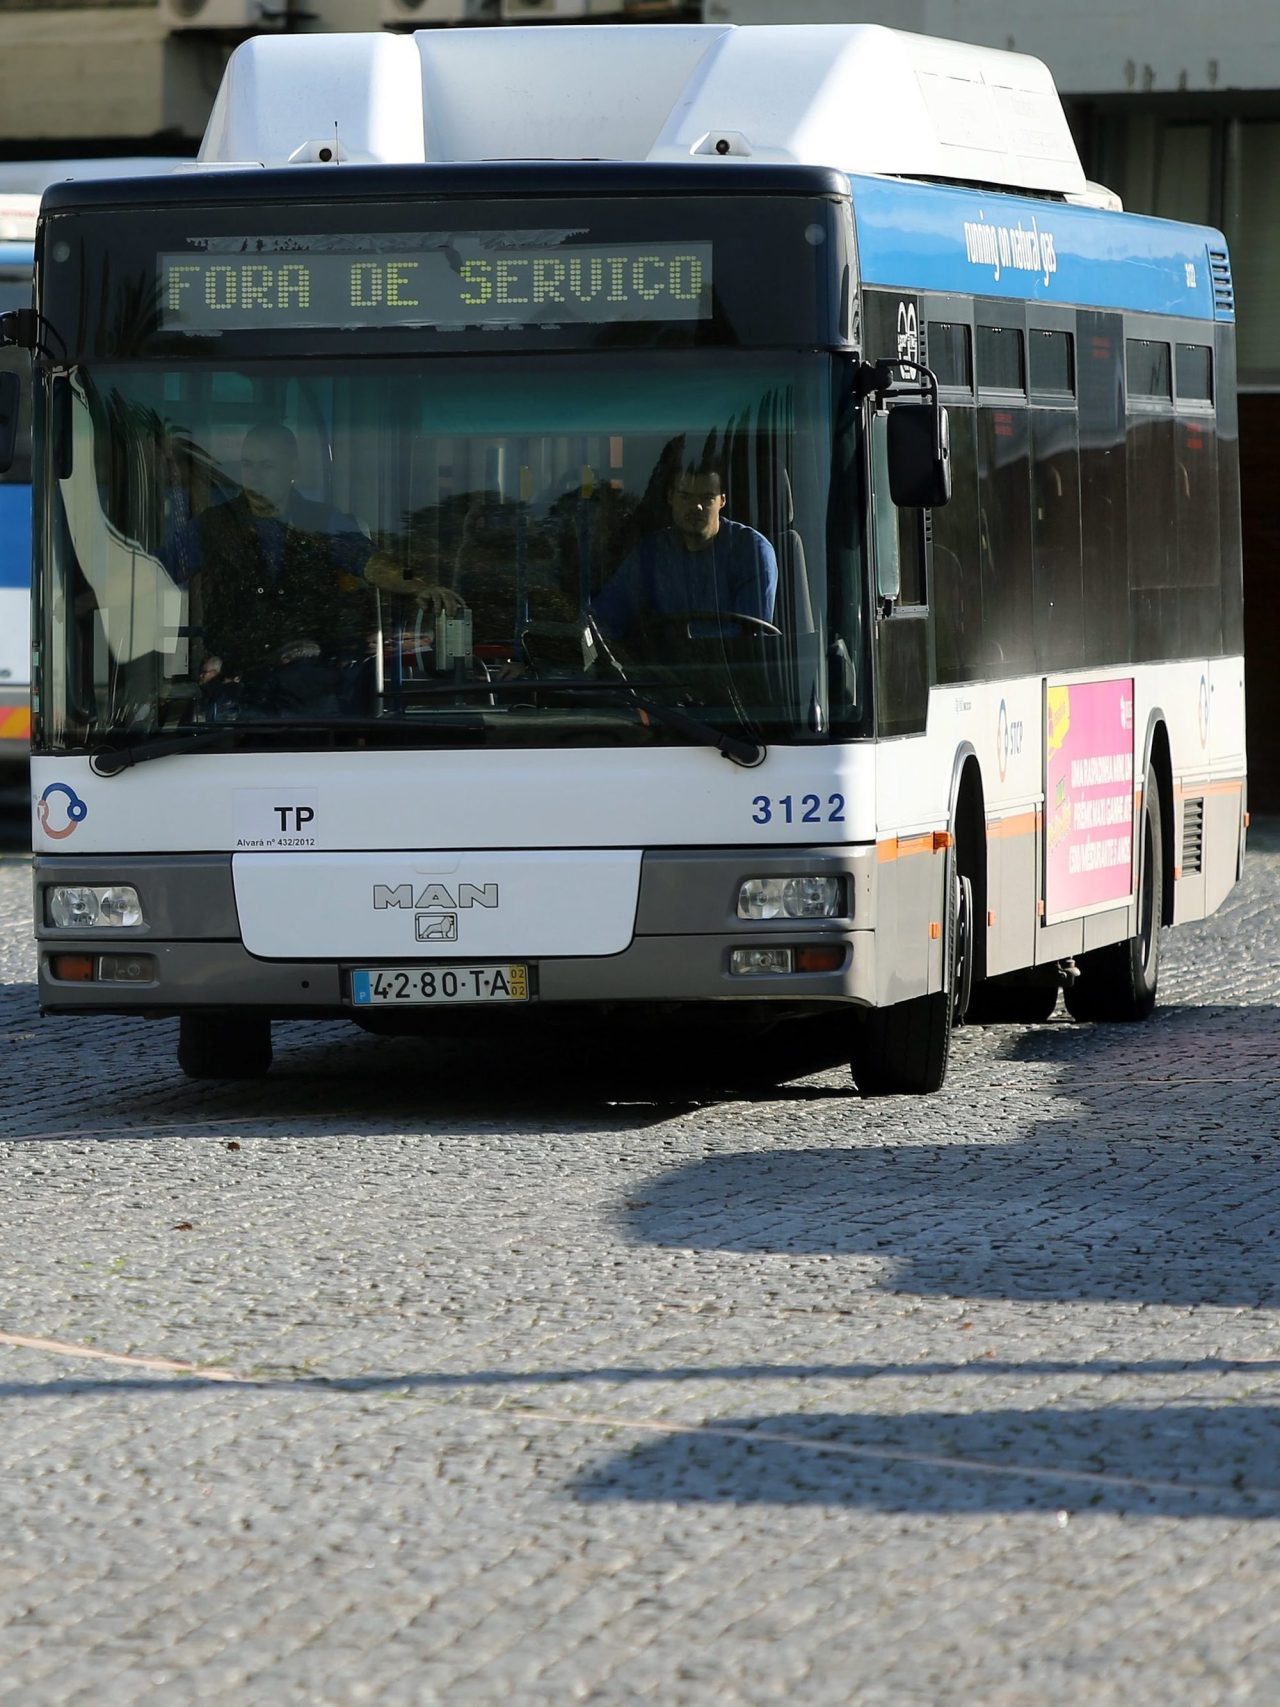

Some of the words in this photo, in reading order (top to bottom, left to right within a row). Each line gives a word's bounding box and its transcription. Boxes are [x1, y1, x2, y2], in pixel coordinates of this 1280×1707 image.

[963, 208, 1000, 281] running
[998, 226, 1012, 267] on
[1010, 215, 1041, 272] natural
[1040, 232, 1057, 287] gas
[167, 263, 310, 310] FORA
[349, 261, 419, 307] DE
[1009, 720, 1024, 756] STCP
[273, 806, 315, 832] TP
[751, 793, 846, 824] 3122
[236, 838, 264, 847] Alvará
[277, 838, 315, 847] 432/2012
[372, 883, 499, 910] MAN
[510, 969, 525, 980] 02
[511, 986, 526, 997] 02
